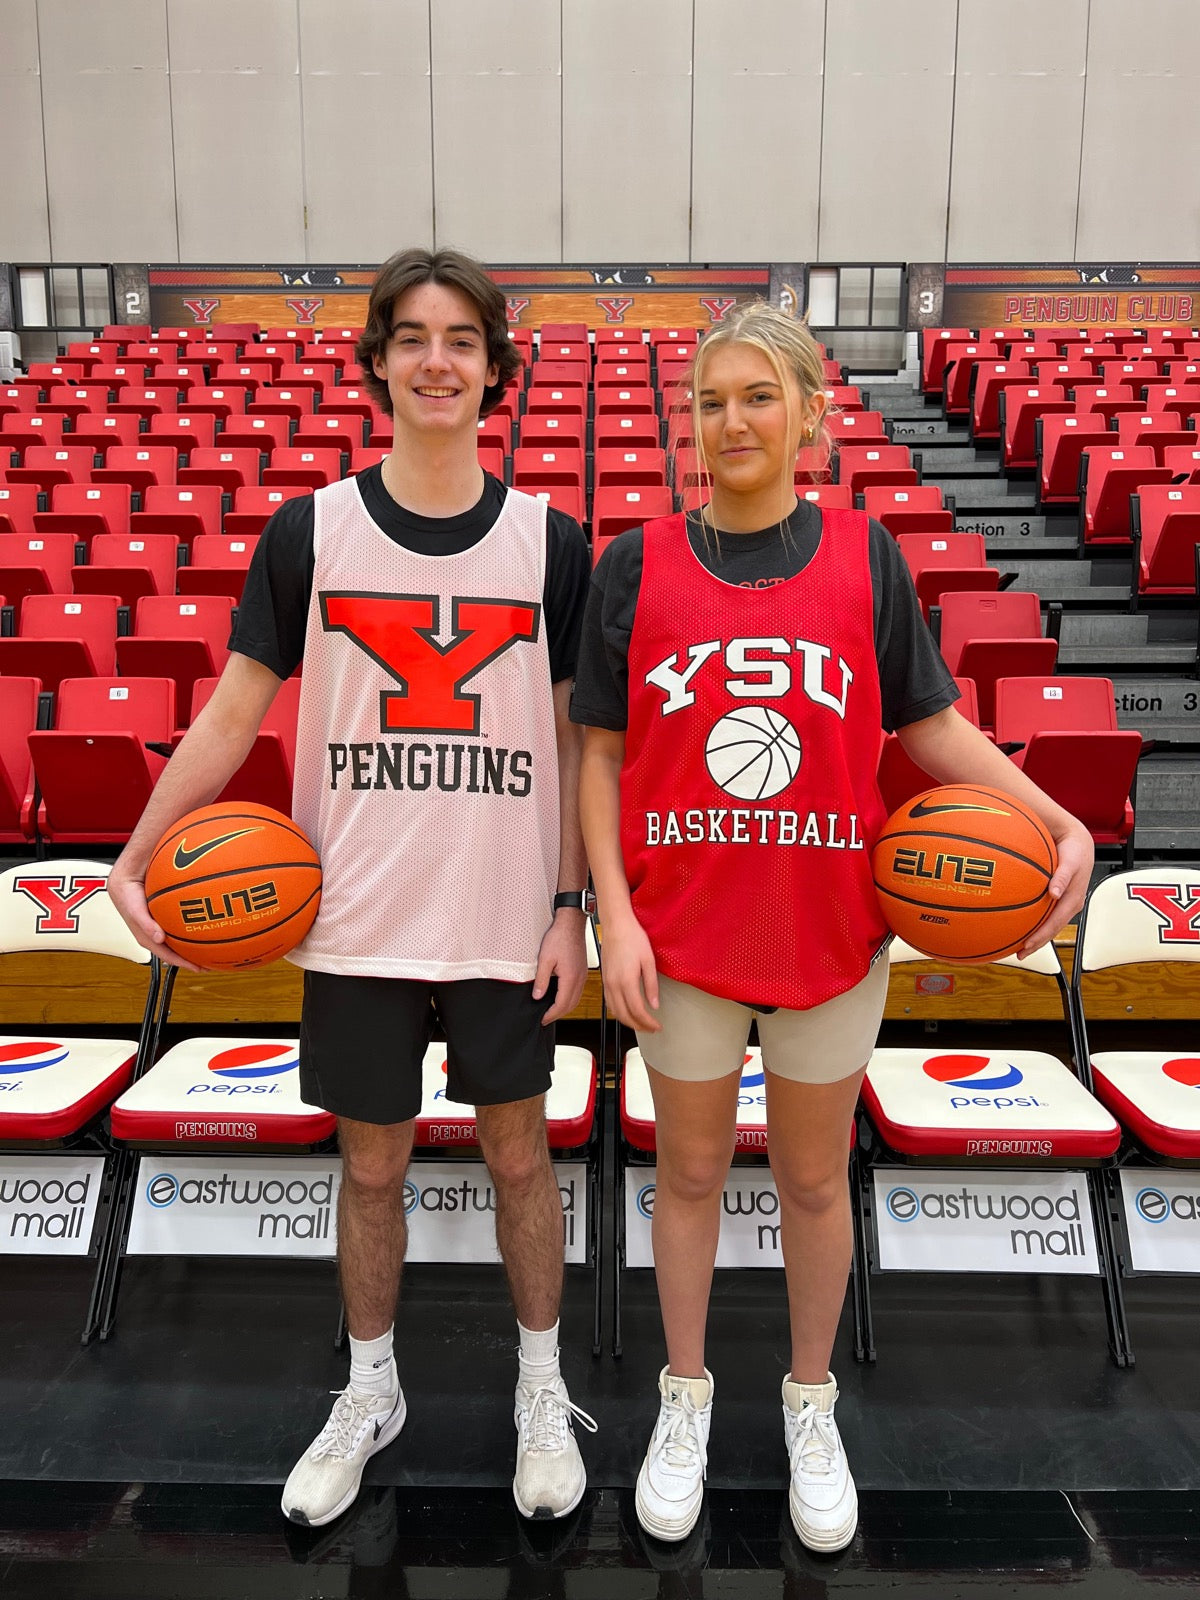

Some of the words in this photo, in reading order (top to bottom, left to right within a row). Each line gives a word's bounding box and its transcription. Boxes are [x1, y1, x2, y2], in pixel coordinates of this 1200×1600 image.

[126, 293, 140, 314] 2
[182, 298, 220, 324] Y
[286, 298, 324, 324] Y
[596, 297, 634, 322] Y
[918, 291, 934, 314] 3
[1004, 295, 1119, 322] PENGUIN
[1127, 295, 1193, 322] CLUB
[955, 523, 1005, 536] ection
[1020, 522, 1031, 536] 3
[318, 590, 541, 736] Y
[644, 637, 854, 721] YSU
[1183, 692, 1198, 711] 3
[328, 742, 532, 797] PENGUINS
[645, 808, 864, 849] BASKETBALL
[892, 848, 996, 888] ELITE
[13, 875, 109, 933] Y
[179, 880, 279, 924] ELITE
[1126, 883, 1200, 944] Y
[185, 907, 280, 932] CHAMPIONSHIP
[187, 1083, 280, 1095] pepsi
[950, 1096, 1039, 1109] pepsi
[175, 1122, 257, 1139] PENGUINS
[966, 1140, 1053, 1156] PENGUINS
[0, 1174, 90, 1203] wood
[148, 1173, 333, 1206] eastwood
[888, 1188, 1080, 1221] eastwood
[10, 1207, 84, 1238] mall
[258, 1208, 330, 1239] mall
[1010, 1223, 1085, 1256] mall
